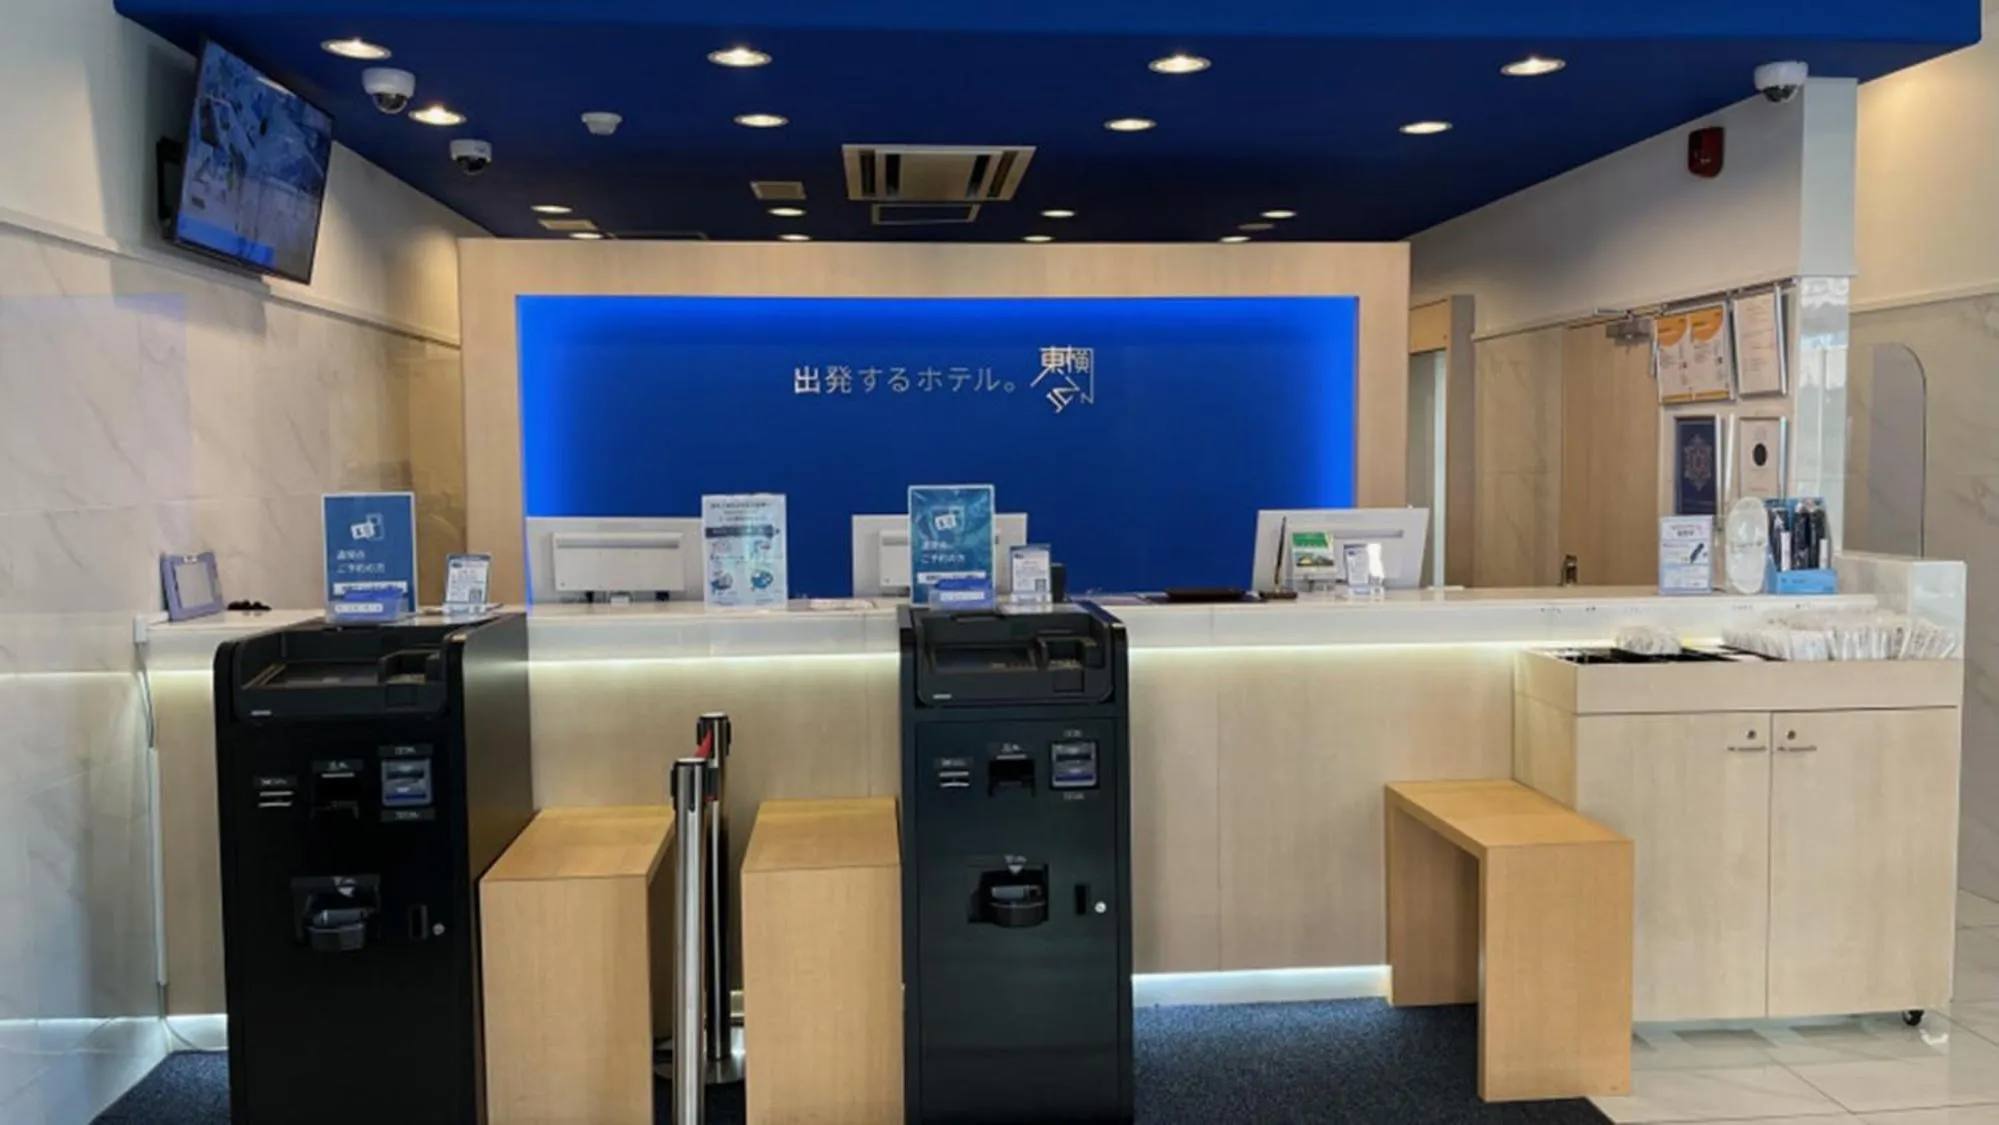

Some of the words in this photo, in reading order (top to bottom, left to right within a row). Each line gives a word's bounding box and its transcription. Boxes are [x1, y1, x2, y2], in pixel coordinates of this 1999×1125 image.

[793, 365, 1016, 396] 出発するホテル。
